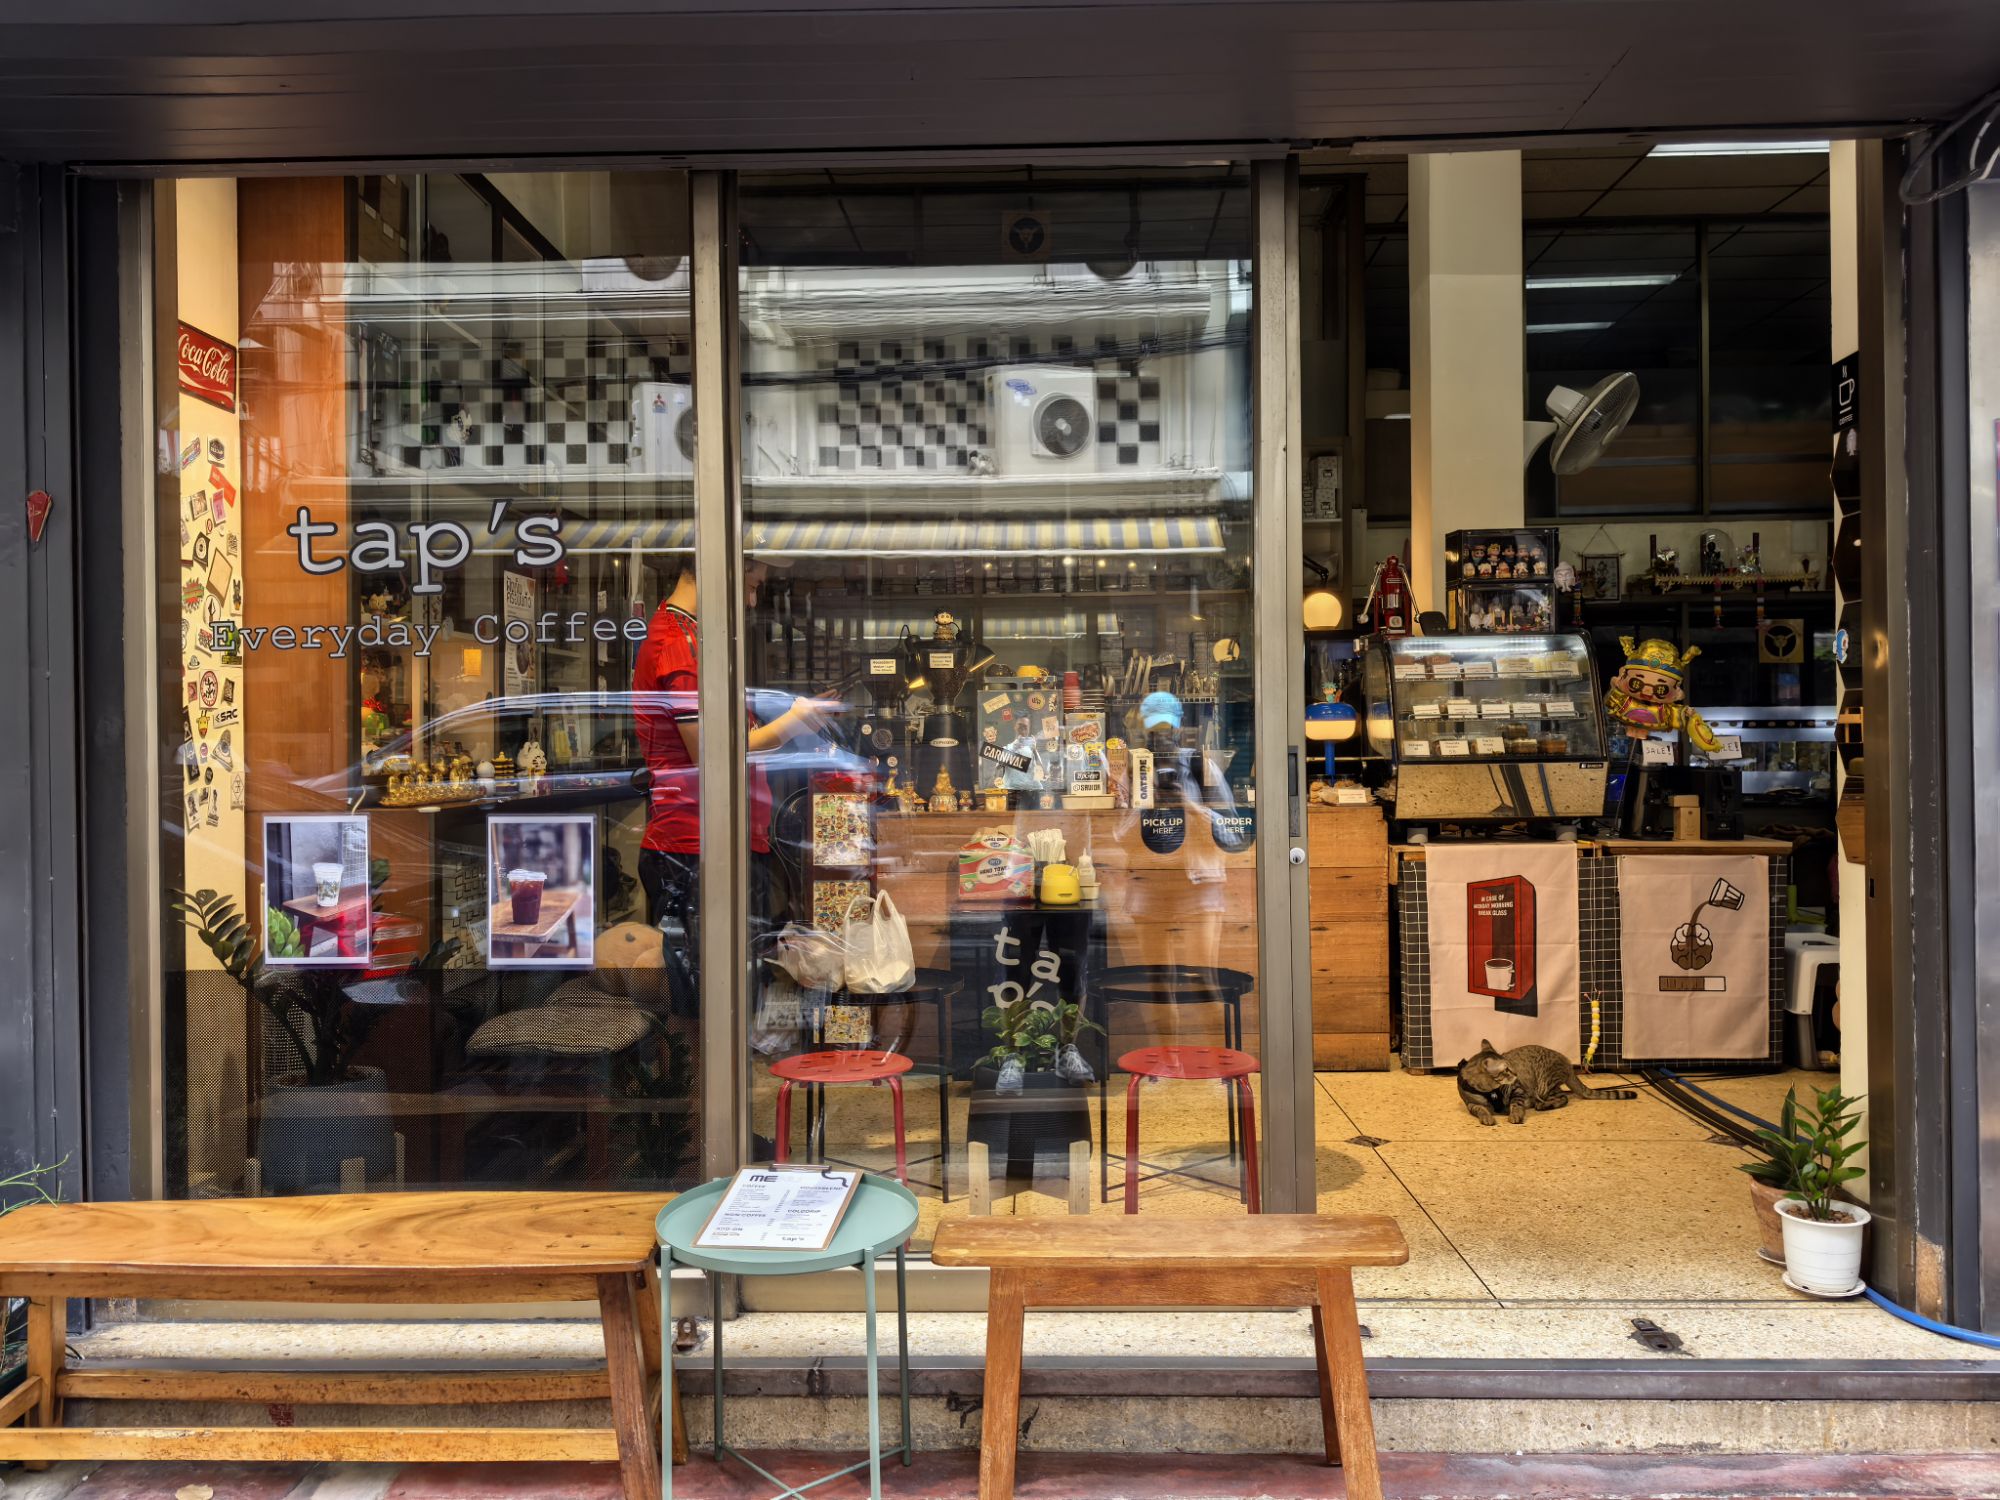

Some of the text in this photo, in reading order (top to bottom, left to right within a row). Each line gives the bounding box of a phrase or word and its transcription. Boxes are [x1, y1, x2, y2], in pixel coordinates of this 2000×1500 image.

[286, 499, 565, 597] tap's
[209, 611, 650, 659] Everyday Coffee
[1645, 745, 1672, 756] SALE!
[983, 745, 1025, 770] CARNIVAL
[1139, 759, 1148, 800] OATSIDE
[1142, 817, 1184, 827] PICK UP
[1216, 817, 1253, 826] ORDER
[1152, 827, 1174, 835] HERE
[1225, 826, 1246, 834] HERE
